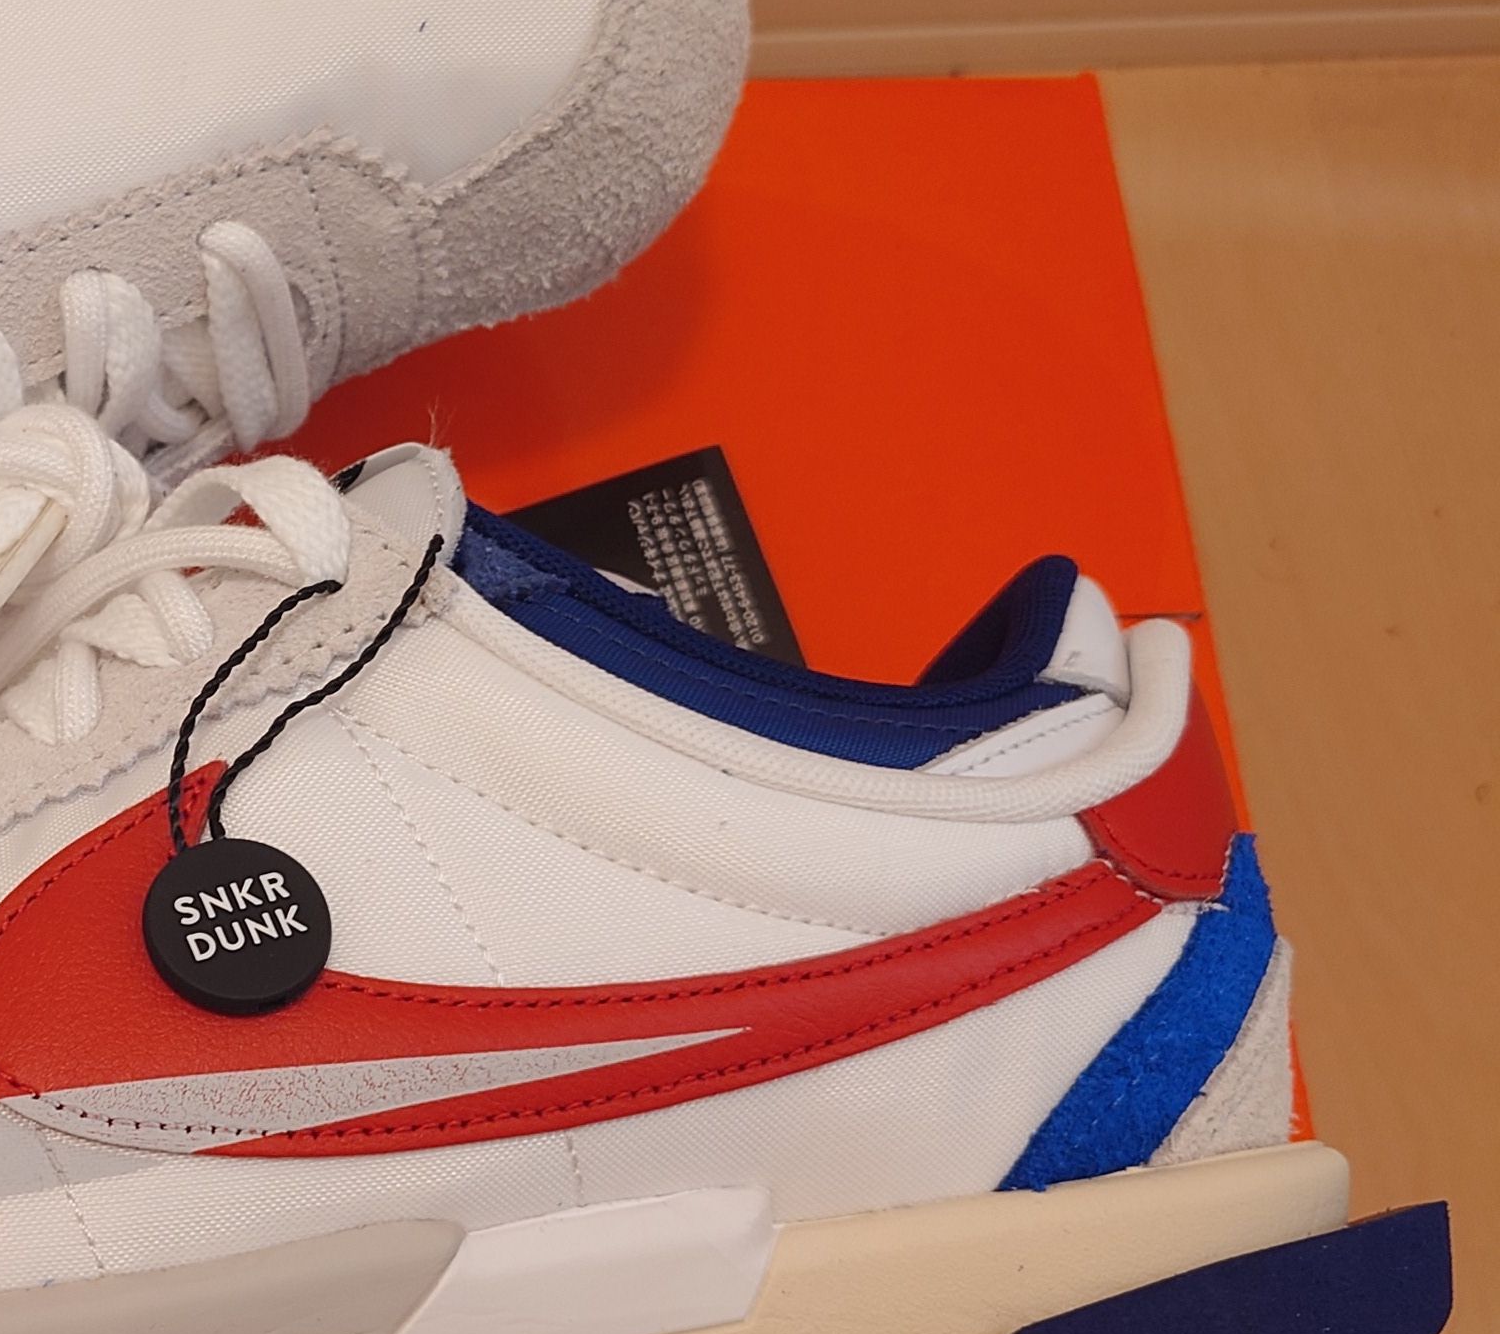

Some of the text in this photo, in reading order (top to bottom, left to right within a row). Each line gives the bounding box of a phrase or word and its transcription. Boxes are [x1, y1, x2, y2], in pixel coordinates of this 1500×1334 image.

[721, 554, 764, 643] 0120-6453-77
[173, 871, 291, 926] SNKR
[186, 904, 309, 962] DUNK
